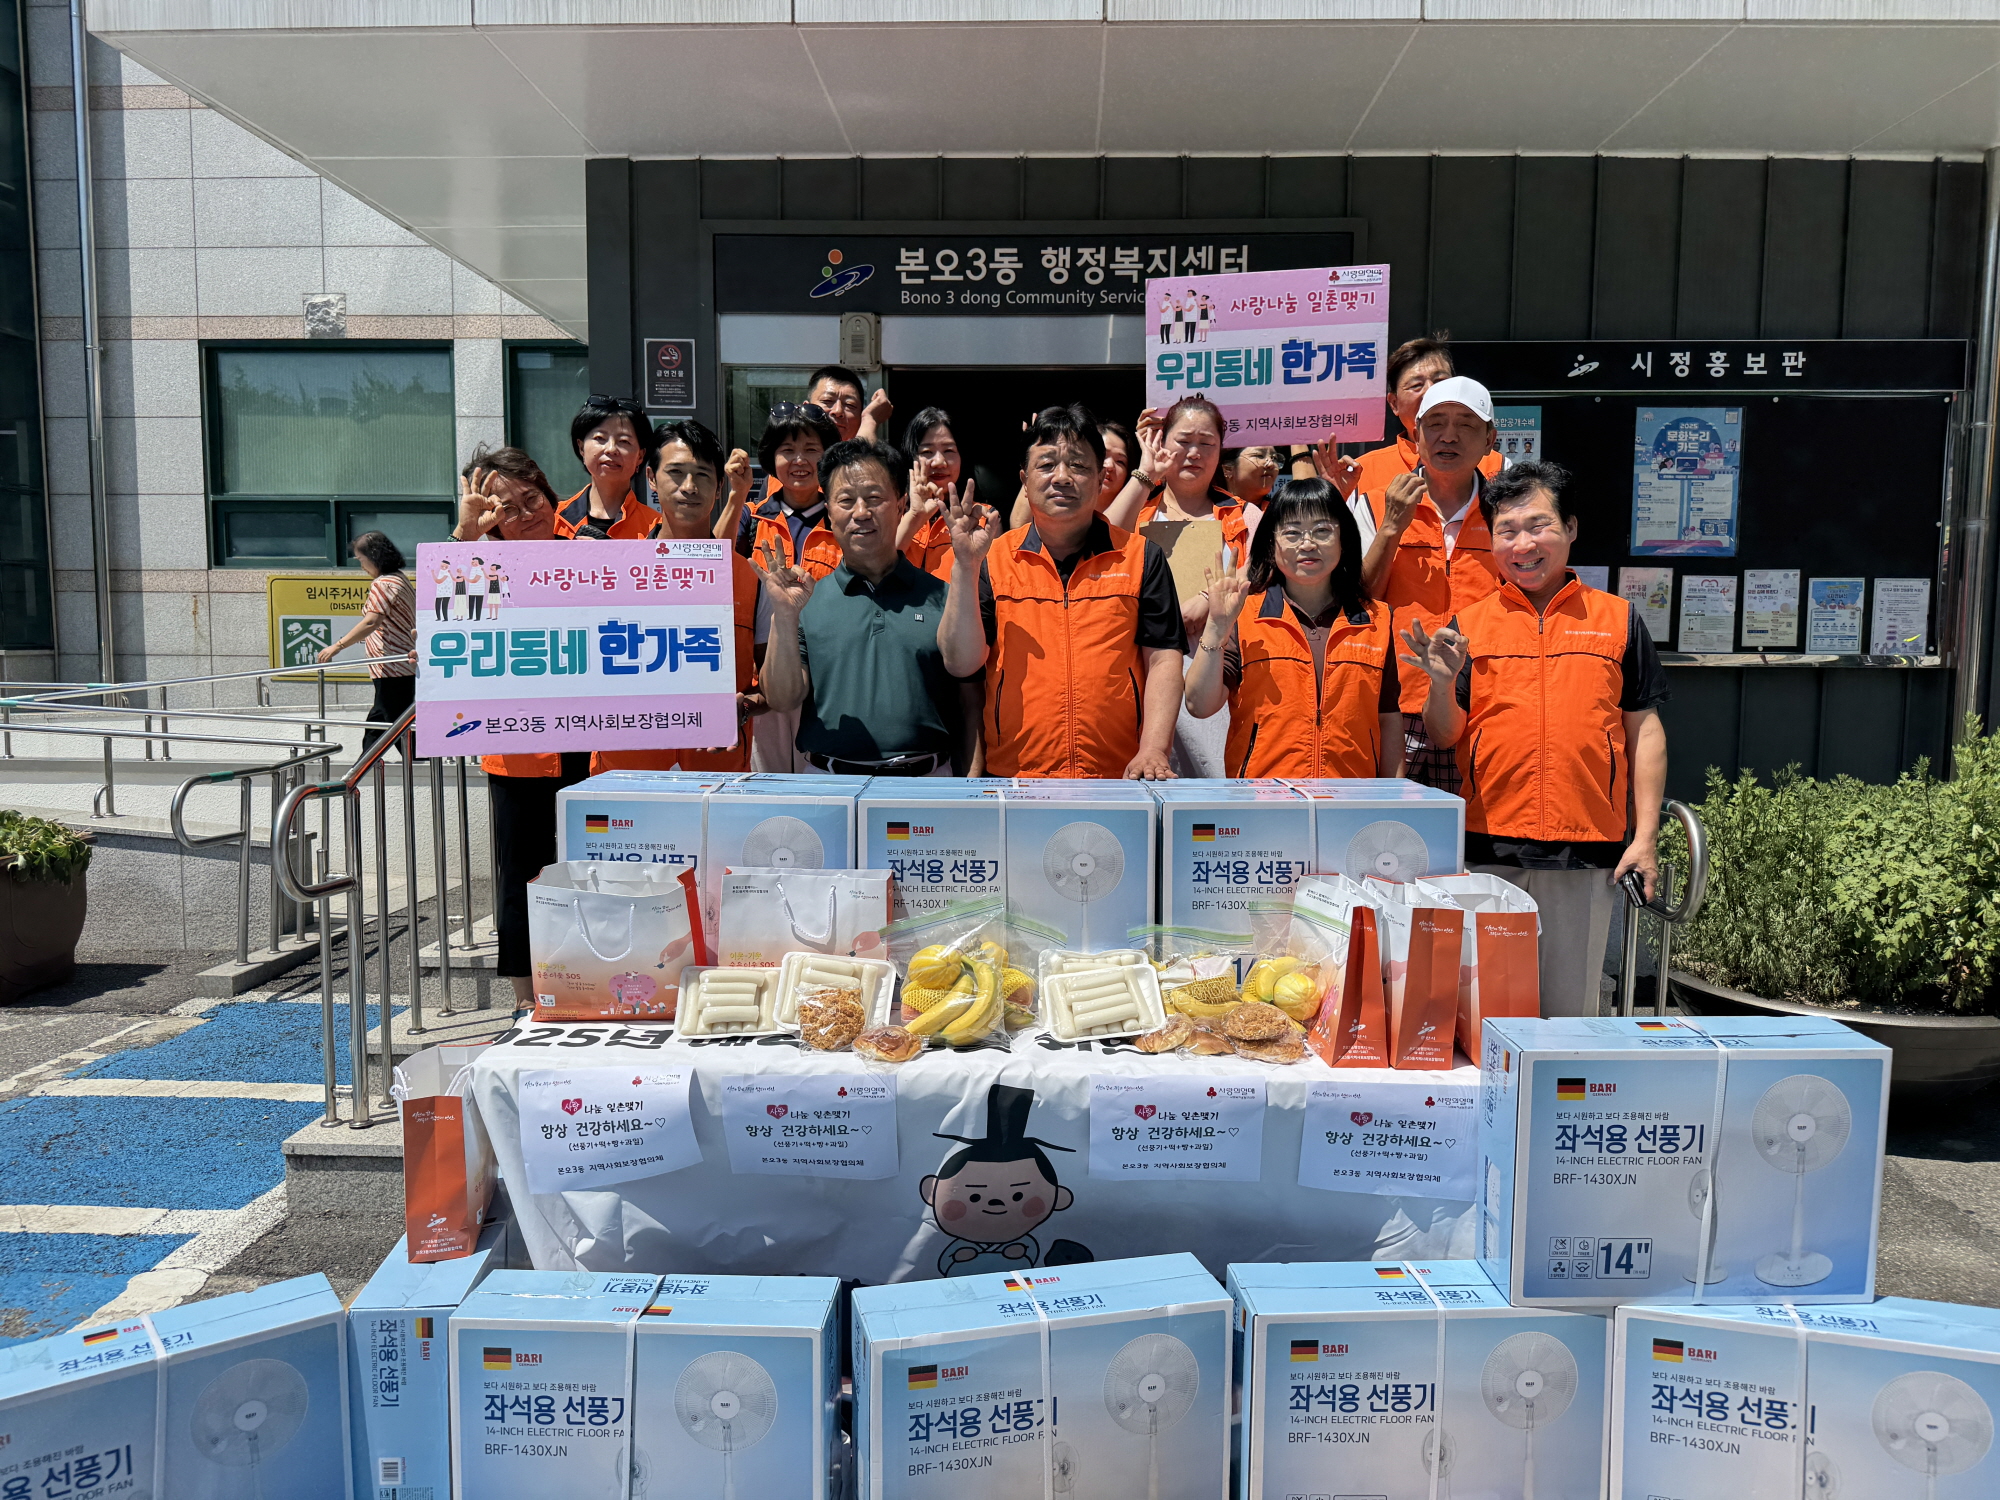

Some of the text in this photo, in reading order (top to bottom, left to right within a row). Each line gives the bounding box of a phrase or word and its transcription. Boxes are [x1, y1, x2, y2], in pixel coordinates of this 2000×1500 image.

[895, 245, 1248, 286] 본오3동 행정복지센터
[901, 290, 941, 305] Bono
[945, 291, 954, 304] 3
[960, 290, 1000, 308] dong
[1006, 290, 1094, 307] Community
[1229, 290, 1375, 316] 사랑나눔 일촌맺기
[1156, 339, 1377, 390] 우리동네 한가족
[1246, 413, 1358, 431] 지역사회보장협의체
[1668, 431, 1710, 441] 문화누리
[1678, 442, 1698, 452] 카드
[672, 544, 721, 553] 사랑의열매
[529, 564, 715, 592] 사랑나눔 일촌맺기
[429, 619, 721, 679] 우리동네 한가족
[485, 712, 702, 734] 본오3동 지역사회보장협의체
[612, 819, 633, 827] BARI
[1192, 861, 1249, 884] 좌석용
[1590, 1083, 1616, 1092] BARI
[564, 1101, 643, 1114] 사랑 나눔 일촌맺기
[770, 1106, 850, 1119] 사랑 나눔 일촌맺기
[1138, 1107, 1219, 1120] 사랑 나눔 일촌맺기
[1353, 1114, 1436, 1130] 사랑 나눔 일촌맺기
[1556, 1112, 1669, 1120] 보다 시원하고 보다 조용해진 바람
[541, 1123, 567, 1139] 항상
[745, 1125, 773, 1137] 항상
[1112, 1127, 1139, 1140] 항상
[1326, 1131, 1353, 1145] 항상
[1555, 1124, 1704, 1153] 좌석용 선풍기
[558, 1155, 664, 1175] 본오3동 지역사회보장협의체
[793, 1158, 864, 1166] 지역사회보장협의체
[1556, 1156, 1702, 1165] 14-INCH ELECTRIC FLOOR FAN
[1333, 1169, 1440, 1182] 본오3동 지역사회보장협의체
[1554, 1173, 1636, 1184] BRF-1430XJN
[1053, 1294, 1103, 1308] 선풍기
[1375, 1291, 1427, 1301] 좌석용
[1819, 1314, 1877, 1329] 선풍기
[1322, 1344, 1348, 1353] BARI
[1688, 1348, 1716, 1360] BARI
[59, 1349, 124, 1372] 좌석용
[379, 1320, 399, 1407] 좌석용 선풍기
[516, 1354, 542, 1363] BARI
[942, 1366, 968, 1378] BARI
[1307, 1372, 1335, 1380] 시원하고
[1338, 1372, 1352, 1380] 보다
[1355, 1372, 1383, 1380] 조용해진
[1386, 1371, 1400, 1380] 바람
[501, 1382, 530, 1390] 시원하고
[533, 1383, 547, 1391] 보다
[550, 1383, 579, 1391] 조용해진
[1652, 1371, 1776, 1395] 보다 시원하고 보다 조용해진 바람
[908, 1388, 1022, 1410] 보다 시원하고 보다 조용해진 바람
[1289, 1383, 1435, 1413] 좌석용 선풍기
[1652, 1384, 1729, 1422] 좌석용
[485, 1394, 555, 1425] 좌석용
[909, 1397, 1057, 1442] 좌석용 선풍기
[1291, 1415, 1434, 1424] 14-INCH ELECTRIC FLOOR FAN
[486, 1427, 610, 1437] 14-INCH ELECTRIC FLOOR
[1652, 1415, 1788, 1442] 14-INCH ELECTRIC FLOOR
[910, 1433, 1034, 1455] 14-INCH ELECTRIC FLOOR
[1289, 1433, 1370, 1443] BRF-1430XJN
[1651, 1432, 1740, 1455] BRF-1430XJN
[23, 1444, 84, 1469] 조용해진 바람
[485, 1444, 567, 1456] BRF-1430XJN
[41, 1444, 132, 1498] 선풍기
[908, 1455, 992, 1476] BRF-1430XJN
[108, 1479, 133, 1493] FAN
